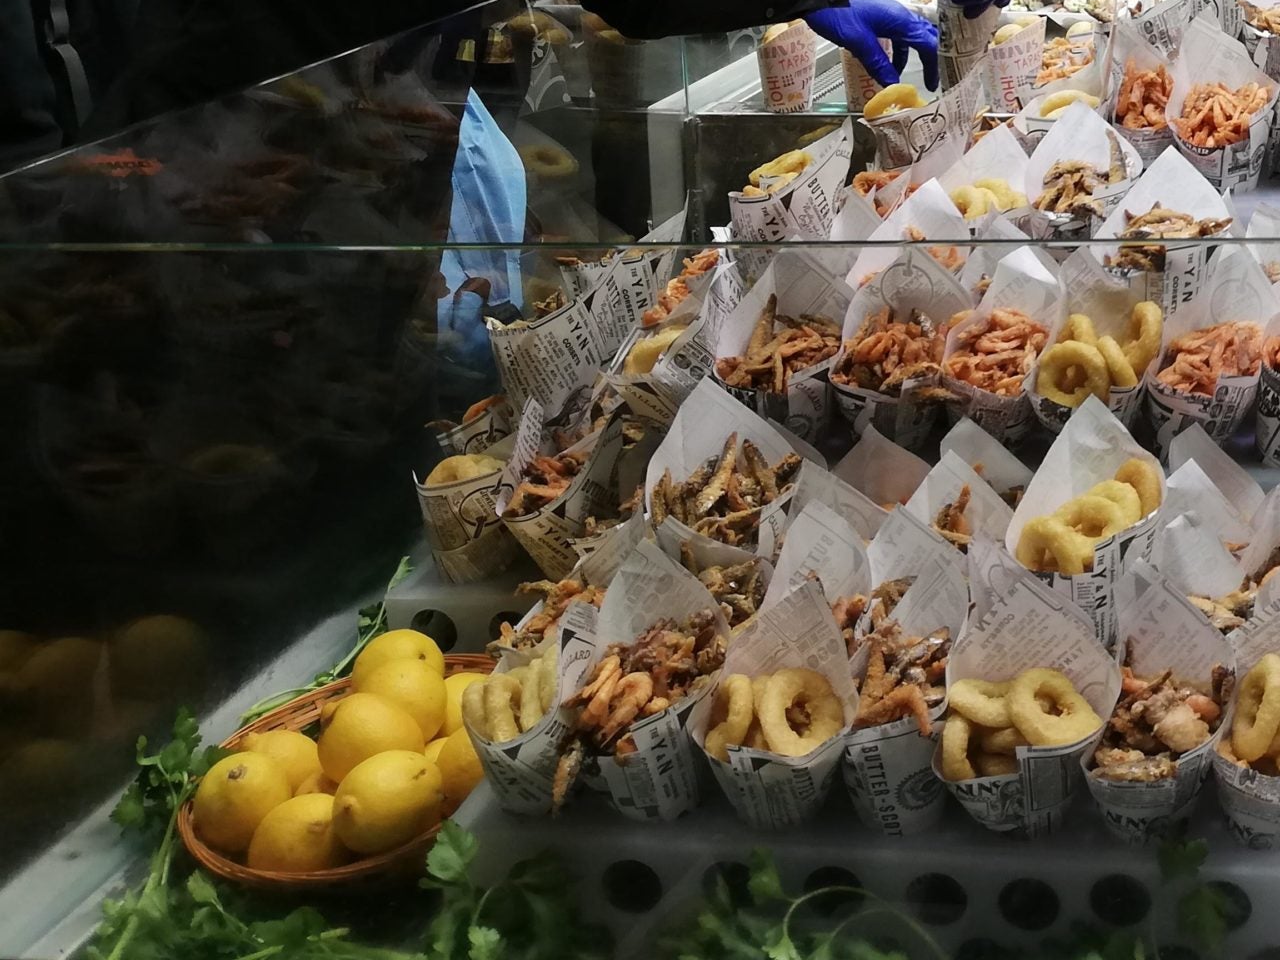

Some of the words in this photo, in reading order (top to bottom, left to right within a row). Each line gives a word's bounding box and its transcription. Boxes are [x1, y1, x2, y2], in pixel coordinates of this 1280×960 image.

[778, 51, 809, 70] TAPAS
[1014, 51, 1041, 71] TAPAS
[625, 386, 670, 420] CALLARD
